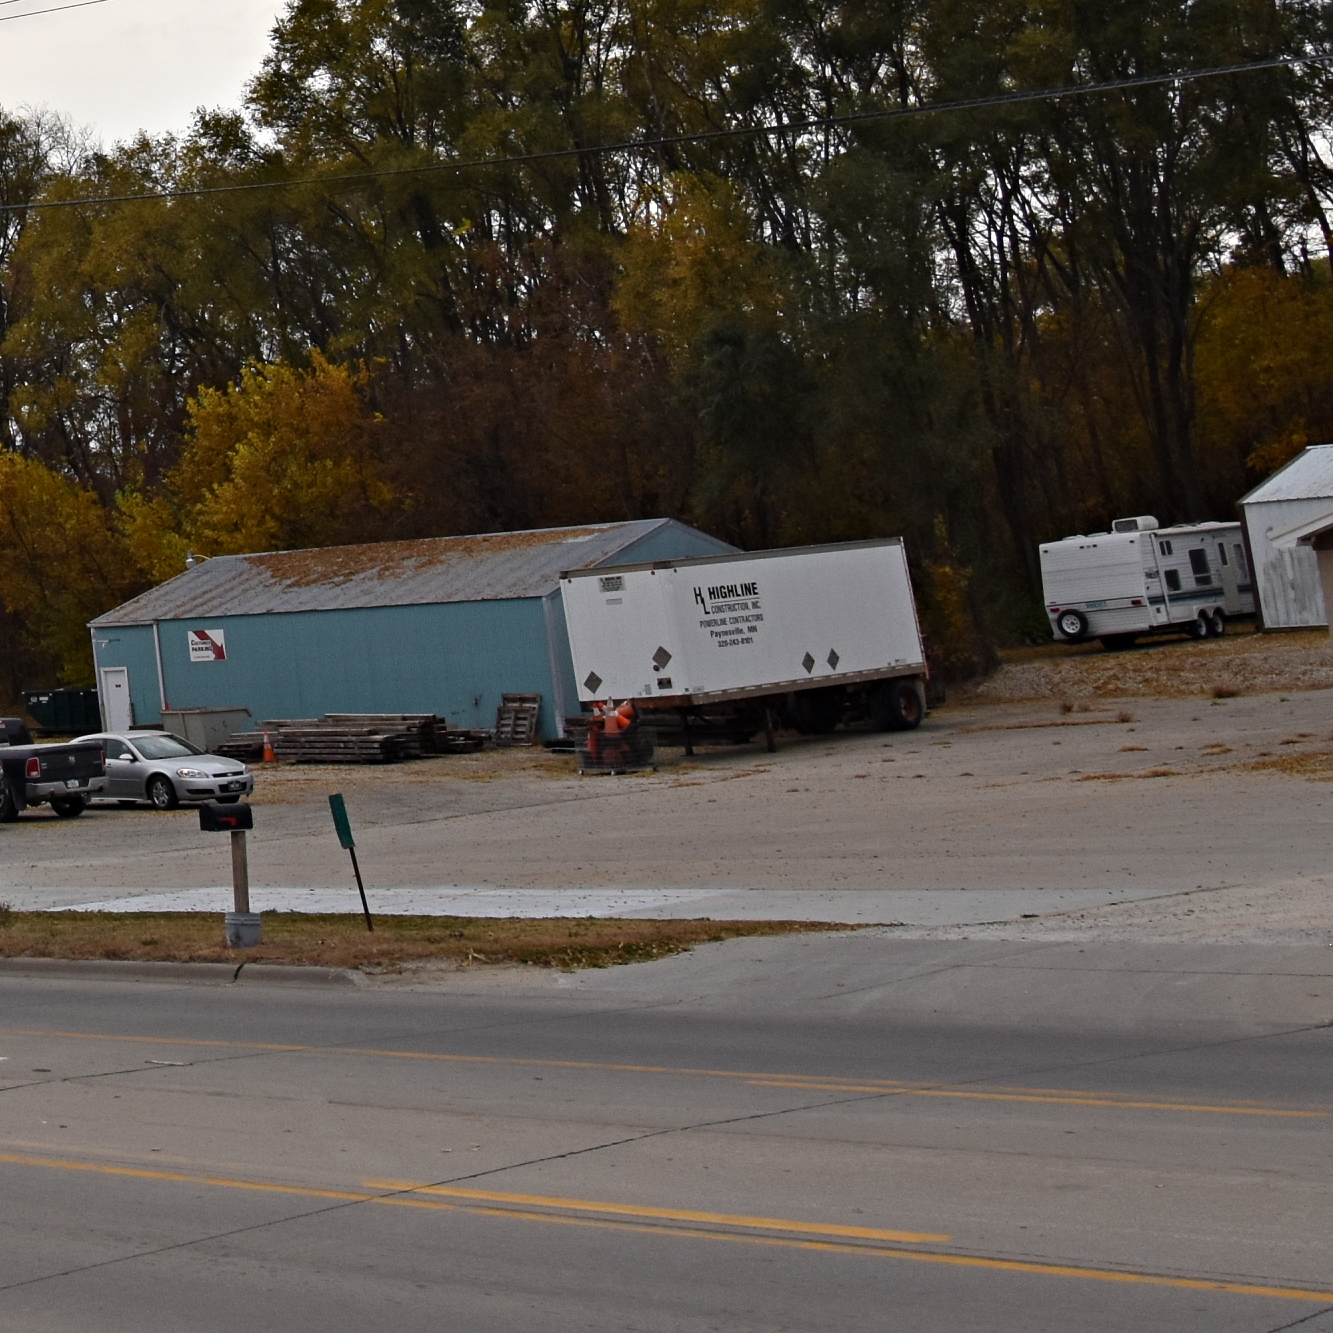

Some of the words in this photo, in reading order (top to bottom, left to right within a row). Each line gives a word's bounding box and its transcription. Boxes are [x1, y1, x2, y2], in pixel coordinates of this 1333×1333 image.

[708, 582, 759, 600] HIGHLINE
[699, 618, 727, 628] POWERLINE
[729, 614, 763, 624] CONTRACTORS
[747, 625, 757, 633] MN
